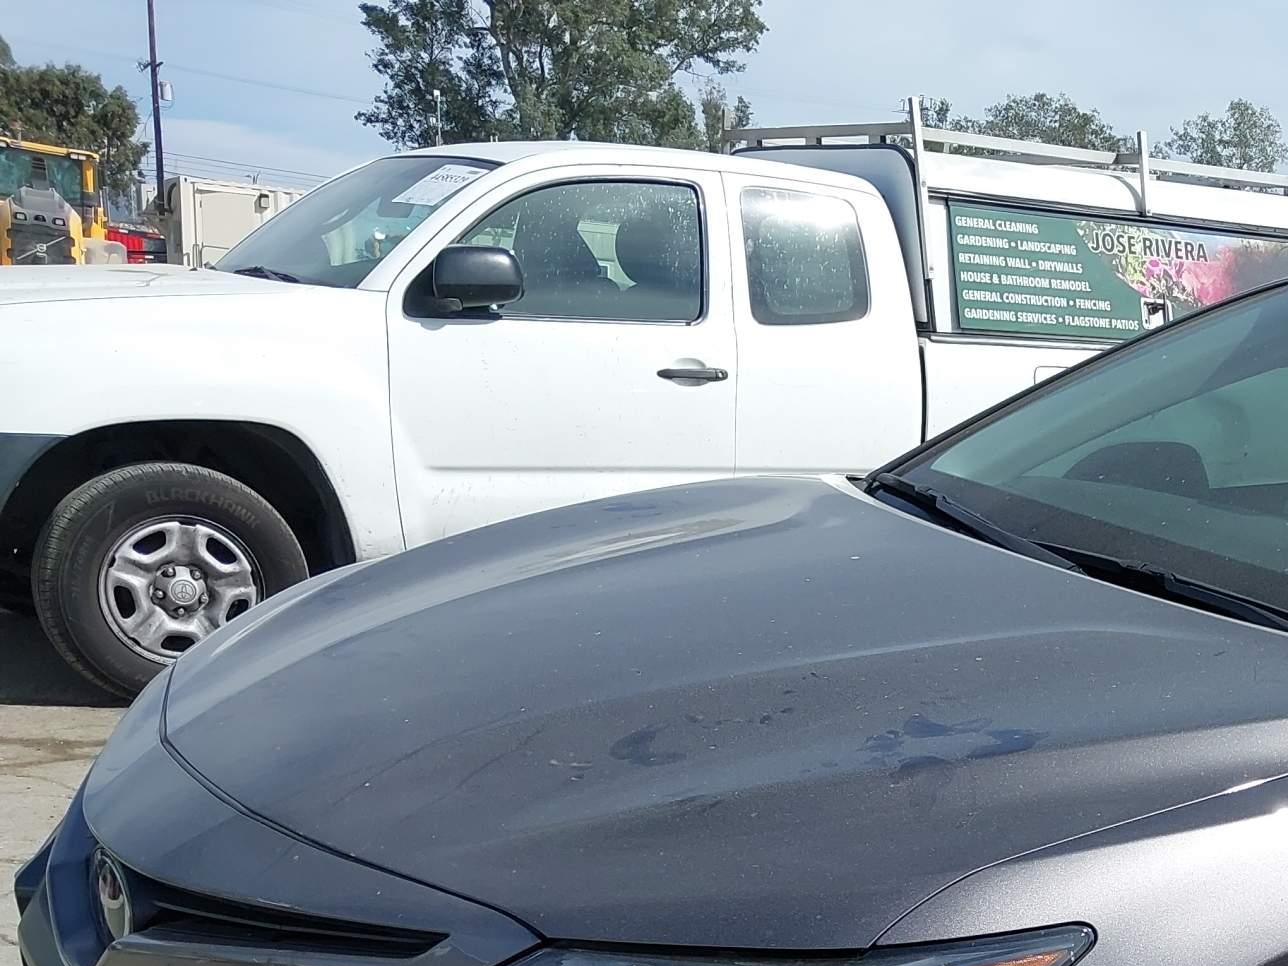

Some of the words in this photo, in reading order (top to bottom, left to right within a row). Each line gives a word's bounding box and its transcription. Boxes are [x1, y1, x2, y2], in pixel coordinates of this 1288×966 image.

[955, 216, 995, 229] GENERAL
[996, 220, 1039, 234] CLEANING
[957, 234, 1009, 249] GARDENING
[1017, 241, 1077, 256] LANDSCAPING
[1089, 231, 1138, 255] JOSE
[1142, 236, 1209, 263] RIVERA
[958, 252, 1006, 267] RETAINING
[1006, 257, 1031, 269] WALL
[1038, 260, 1083, 274] DRYWALLS
[960, 271, 992, 283] HOUSE
[992, 274, 1000, 284] &
[1001, 275, 1050, 289] BATHROOM
[1051, 279, 1091, 292] REMODEL
[962, 289, 1002, 303] GENERAL
[1003, 293, 1068, 307] CONSTRUCTION
[1076, 299, 1111, 311] FENCING
[964, 307, 1016, 322] GARDENING
[1017, 312, 1057, 325] SERVICES
[1065, 315, 1111, 329] FLAGSTONE
[1111, 319, 1140, 331] PATIOS
